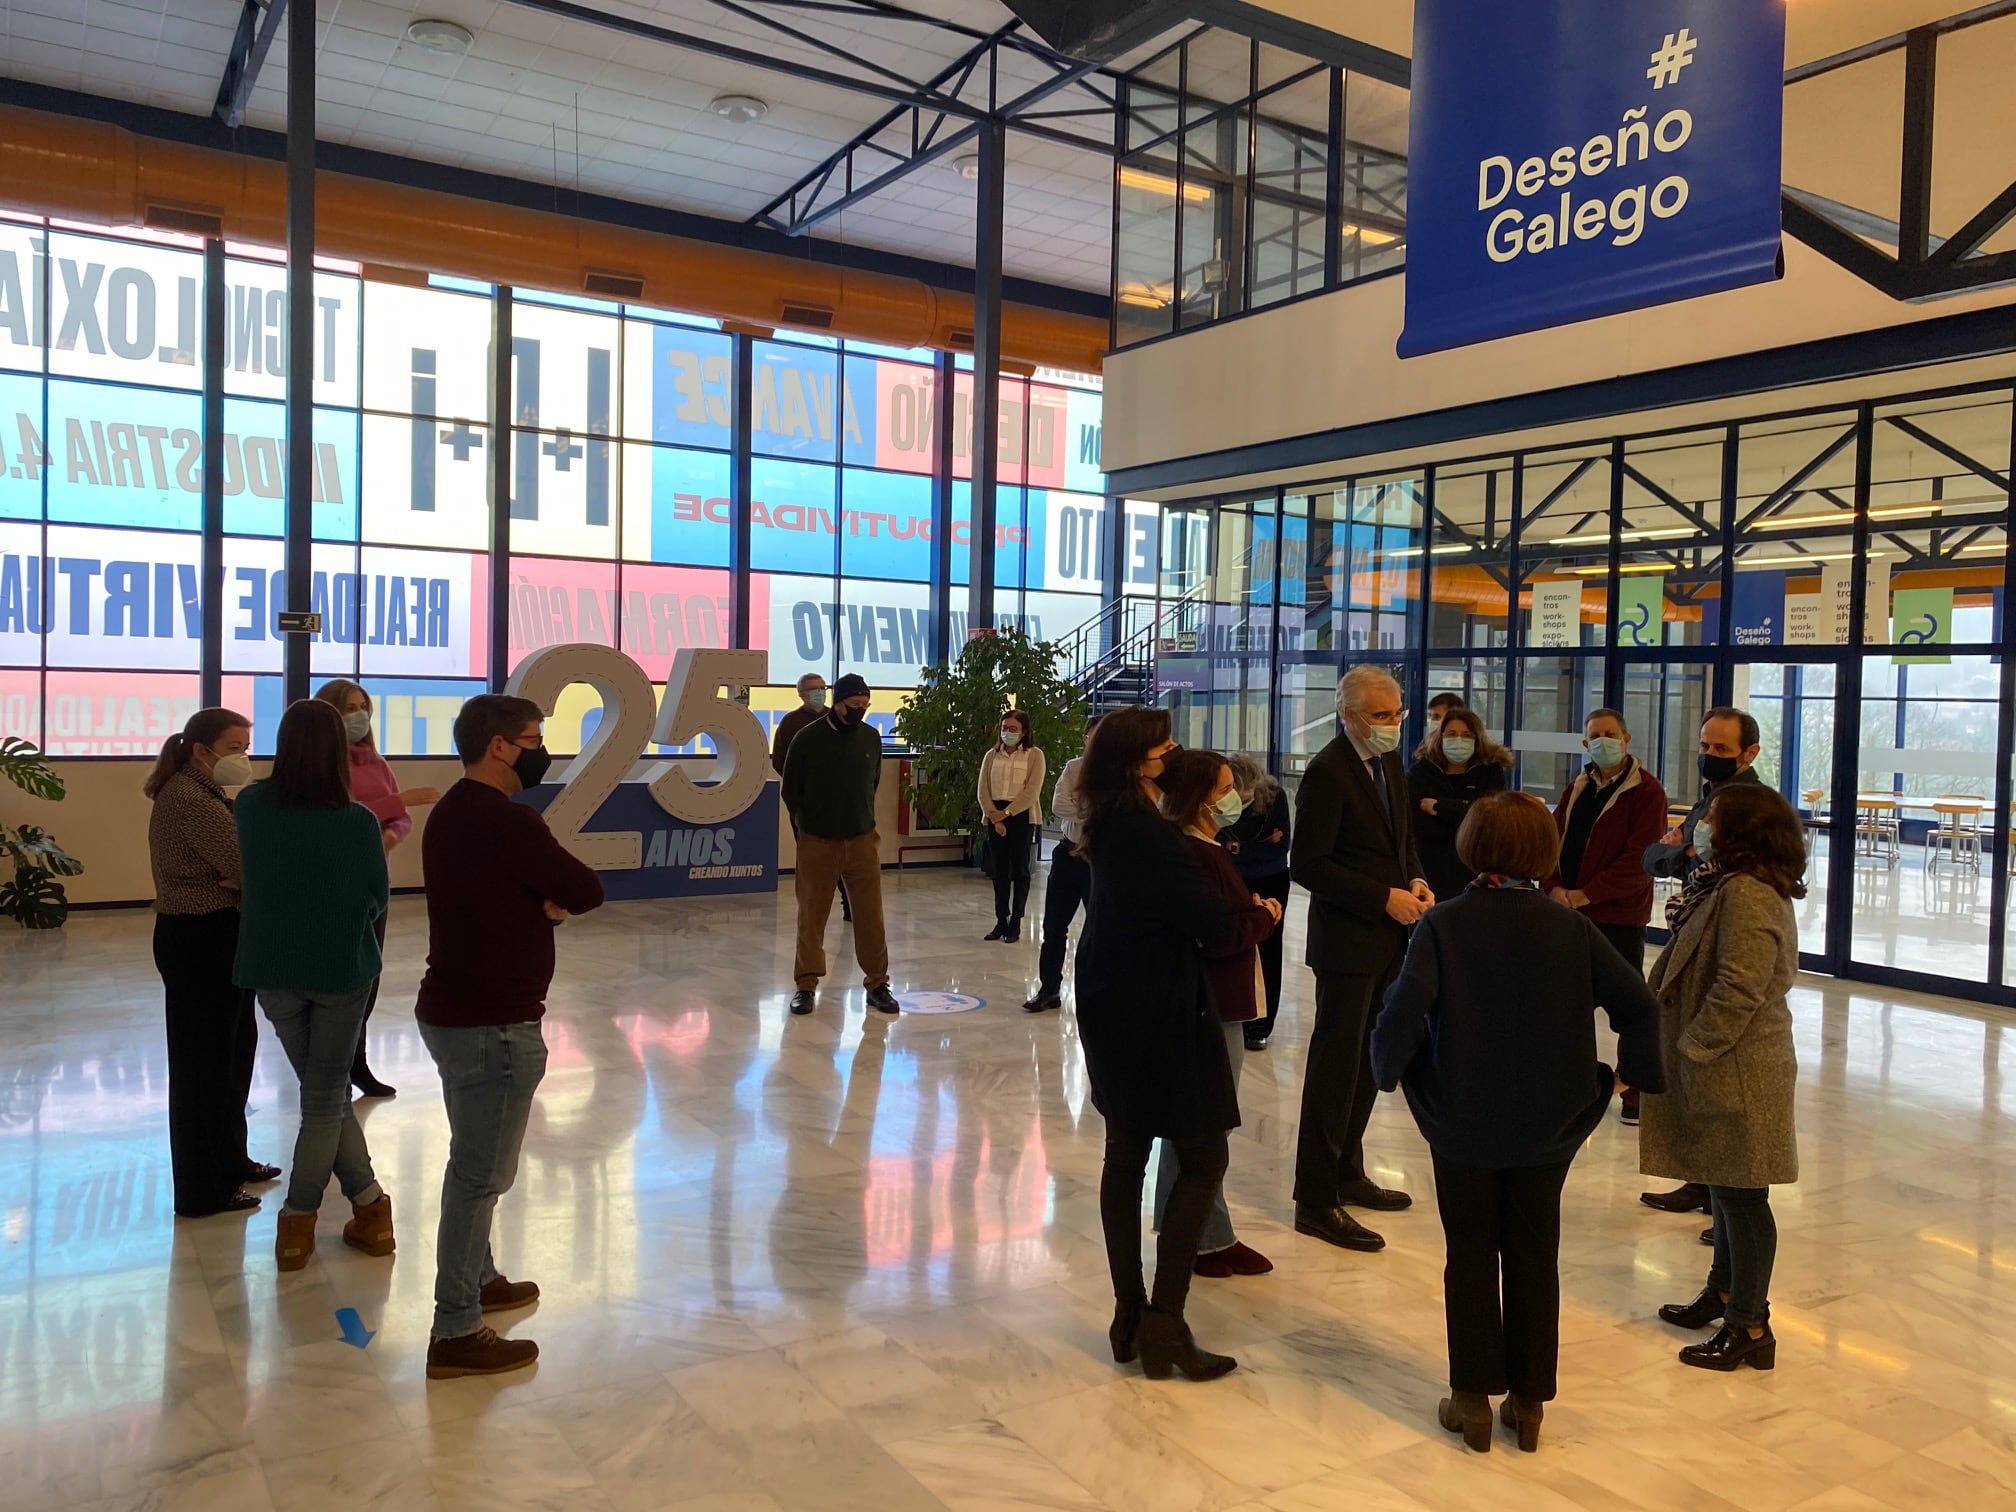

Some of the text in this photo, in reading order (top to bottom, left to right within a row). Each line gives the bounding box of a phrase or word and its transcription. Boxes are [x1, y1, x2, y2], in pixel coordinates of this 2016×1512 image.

[1647, 28, 1697, 89] #
[1478, 105, 1693, 211] Deseño
[1486, 175, 1689, 262] Galego
[1543, 612, 1565, 620] work-
[1542, 621, 1567, 629] shops
[1735, 626, 1771, 636] Deseño
[1790, 623, 1814, 631] work-
[1737, 635, 1771, 646] Galego
[1790, 631, 1816, 640] shops
[504, 643, 770, 871] 25
[643, 828, 735, 868] ANOS
[689, 864, 763, 879] CREANDO XUNTOS
